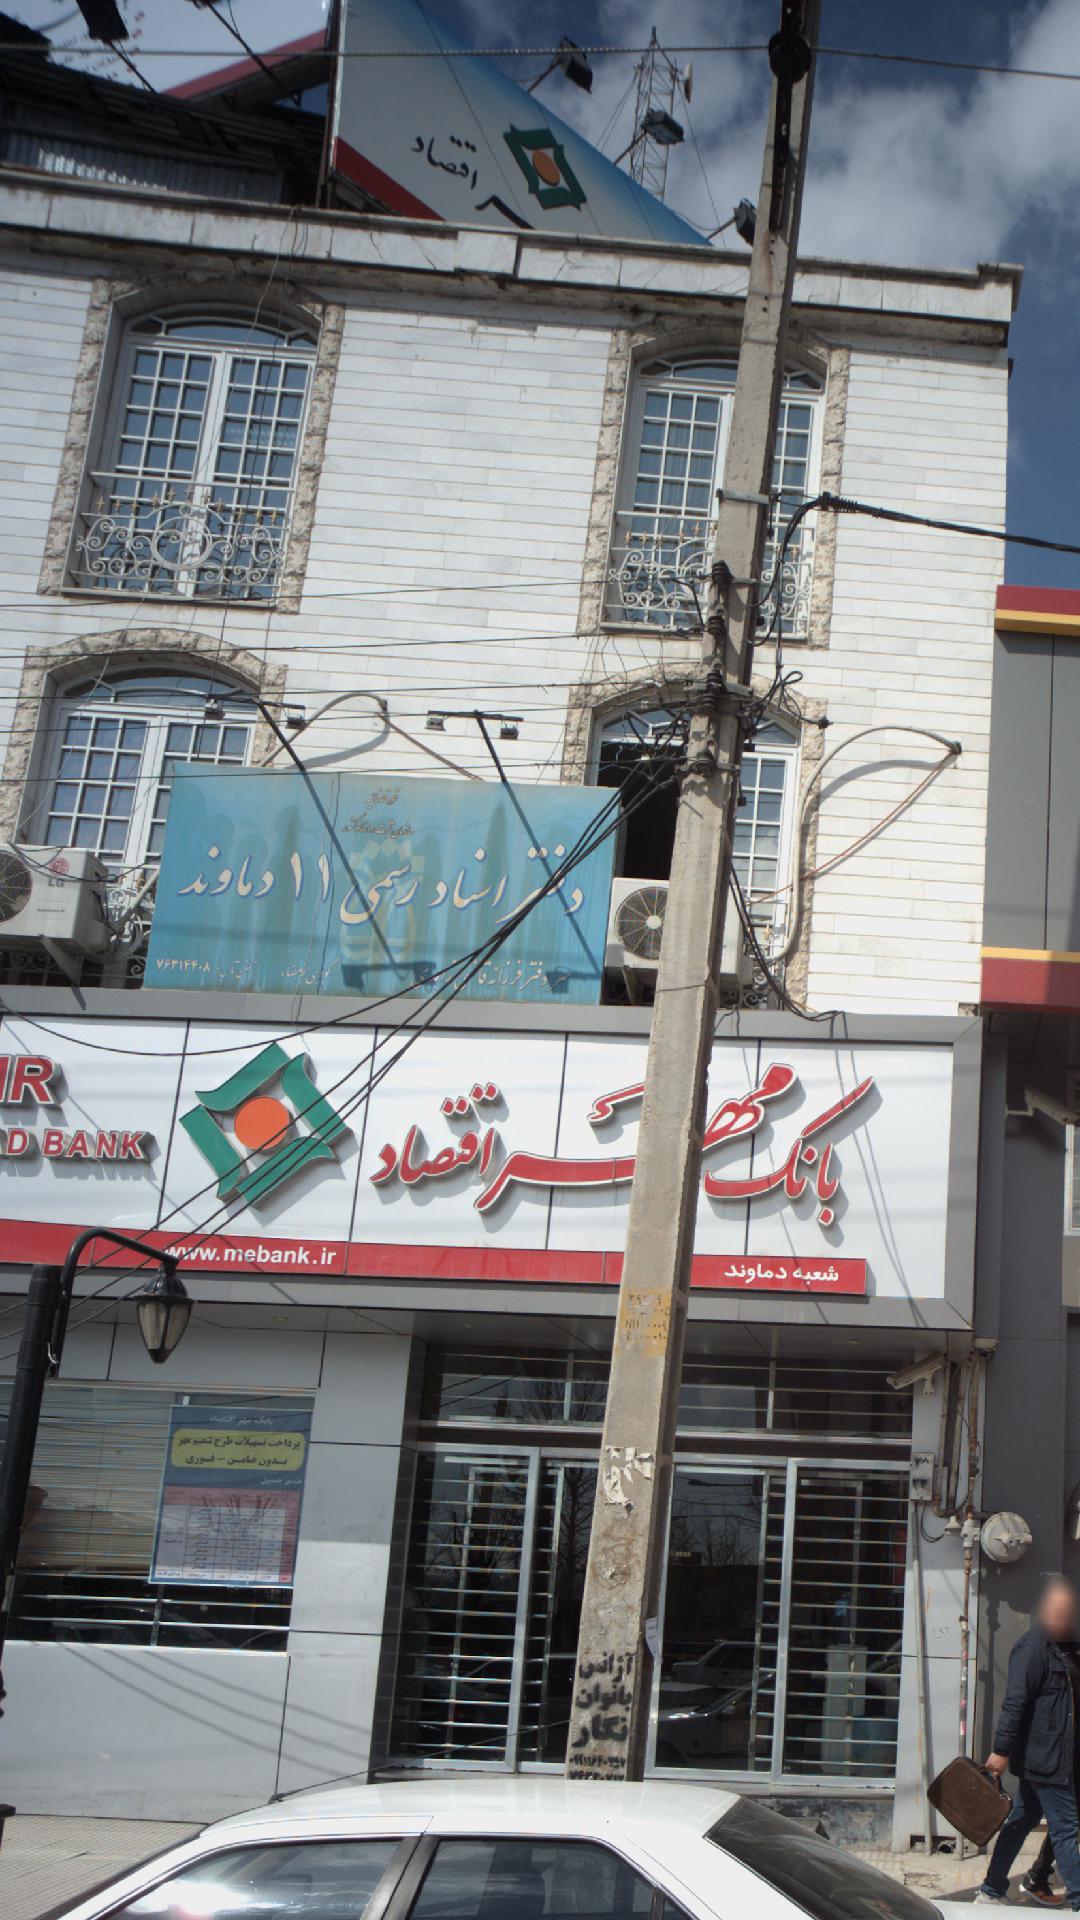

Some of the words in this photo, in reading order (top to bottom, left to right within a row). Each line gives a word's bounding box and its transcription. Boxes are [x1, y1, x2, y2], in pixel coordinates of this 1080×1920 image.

[411, 135, 478, 190] اقتصاد
[47, 878, 65, 888] LG
[177, 846, 274, 898] دماوند
[340, 864, 418, 923] رسمی
[427, 847, 508, 909] اسناد
[496, 843, 583, 923] دفتر
[40, 1128, 145, 1159] BANK
[370, 1082, 501, 1186] اقتصاد
[703, 1075, 874, 1227] بانک
[164, 1244, 337, 1265] www.mebank.ir
[723, 1263, 788, 1284] دماوند
[792, 1265, 840, 1285] شعبه
[575, 1684, 633, 1712] بانوان
[571, 1713, 628, 1748] نگار
